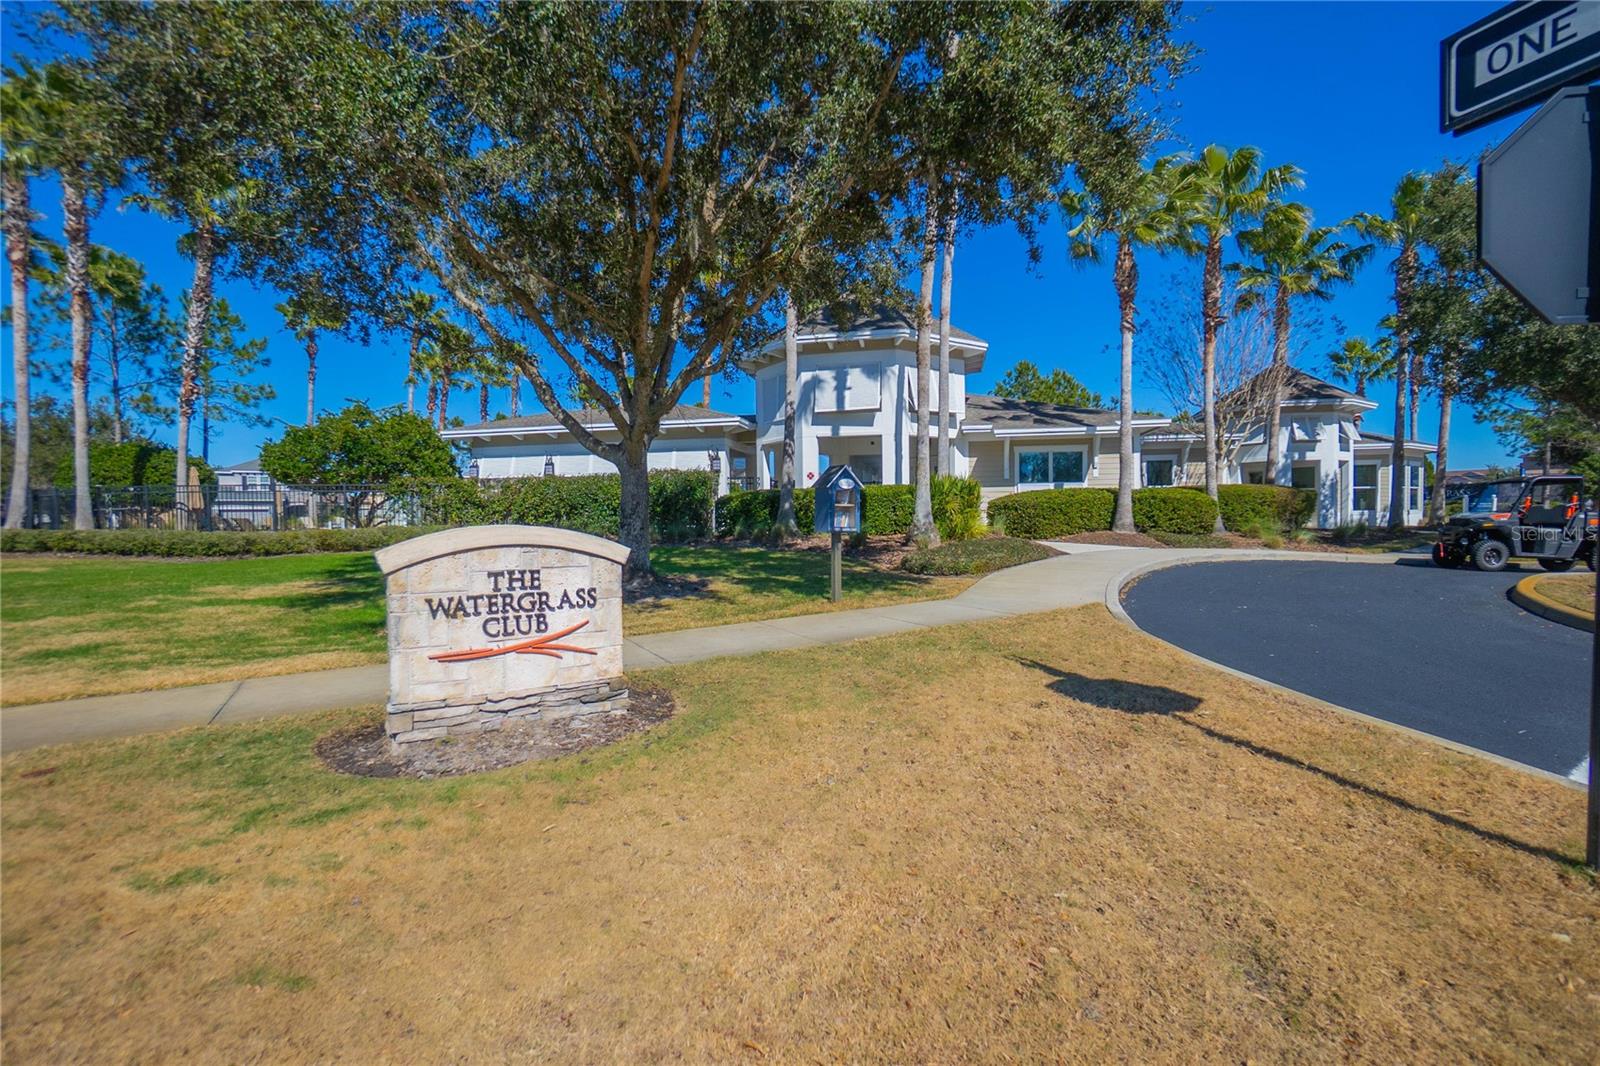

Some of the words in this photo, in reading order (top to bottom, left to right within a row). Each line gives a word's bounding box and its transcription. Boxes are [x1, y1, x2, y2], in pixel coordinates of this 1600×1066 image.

[1487, 8, 1578, 74] ONE
[487, 569, 541, 592] THE
[424, 587, 597, 620] WATERGRASS
[482, 613, 549, 638] CLUB
